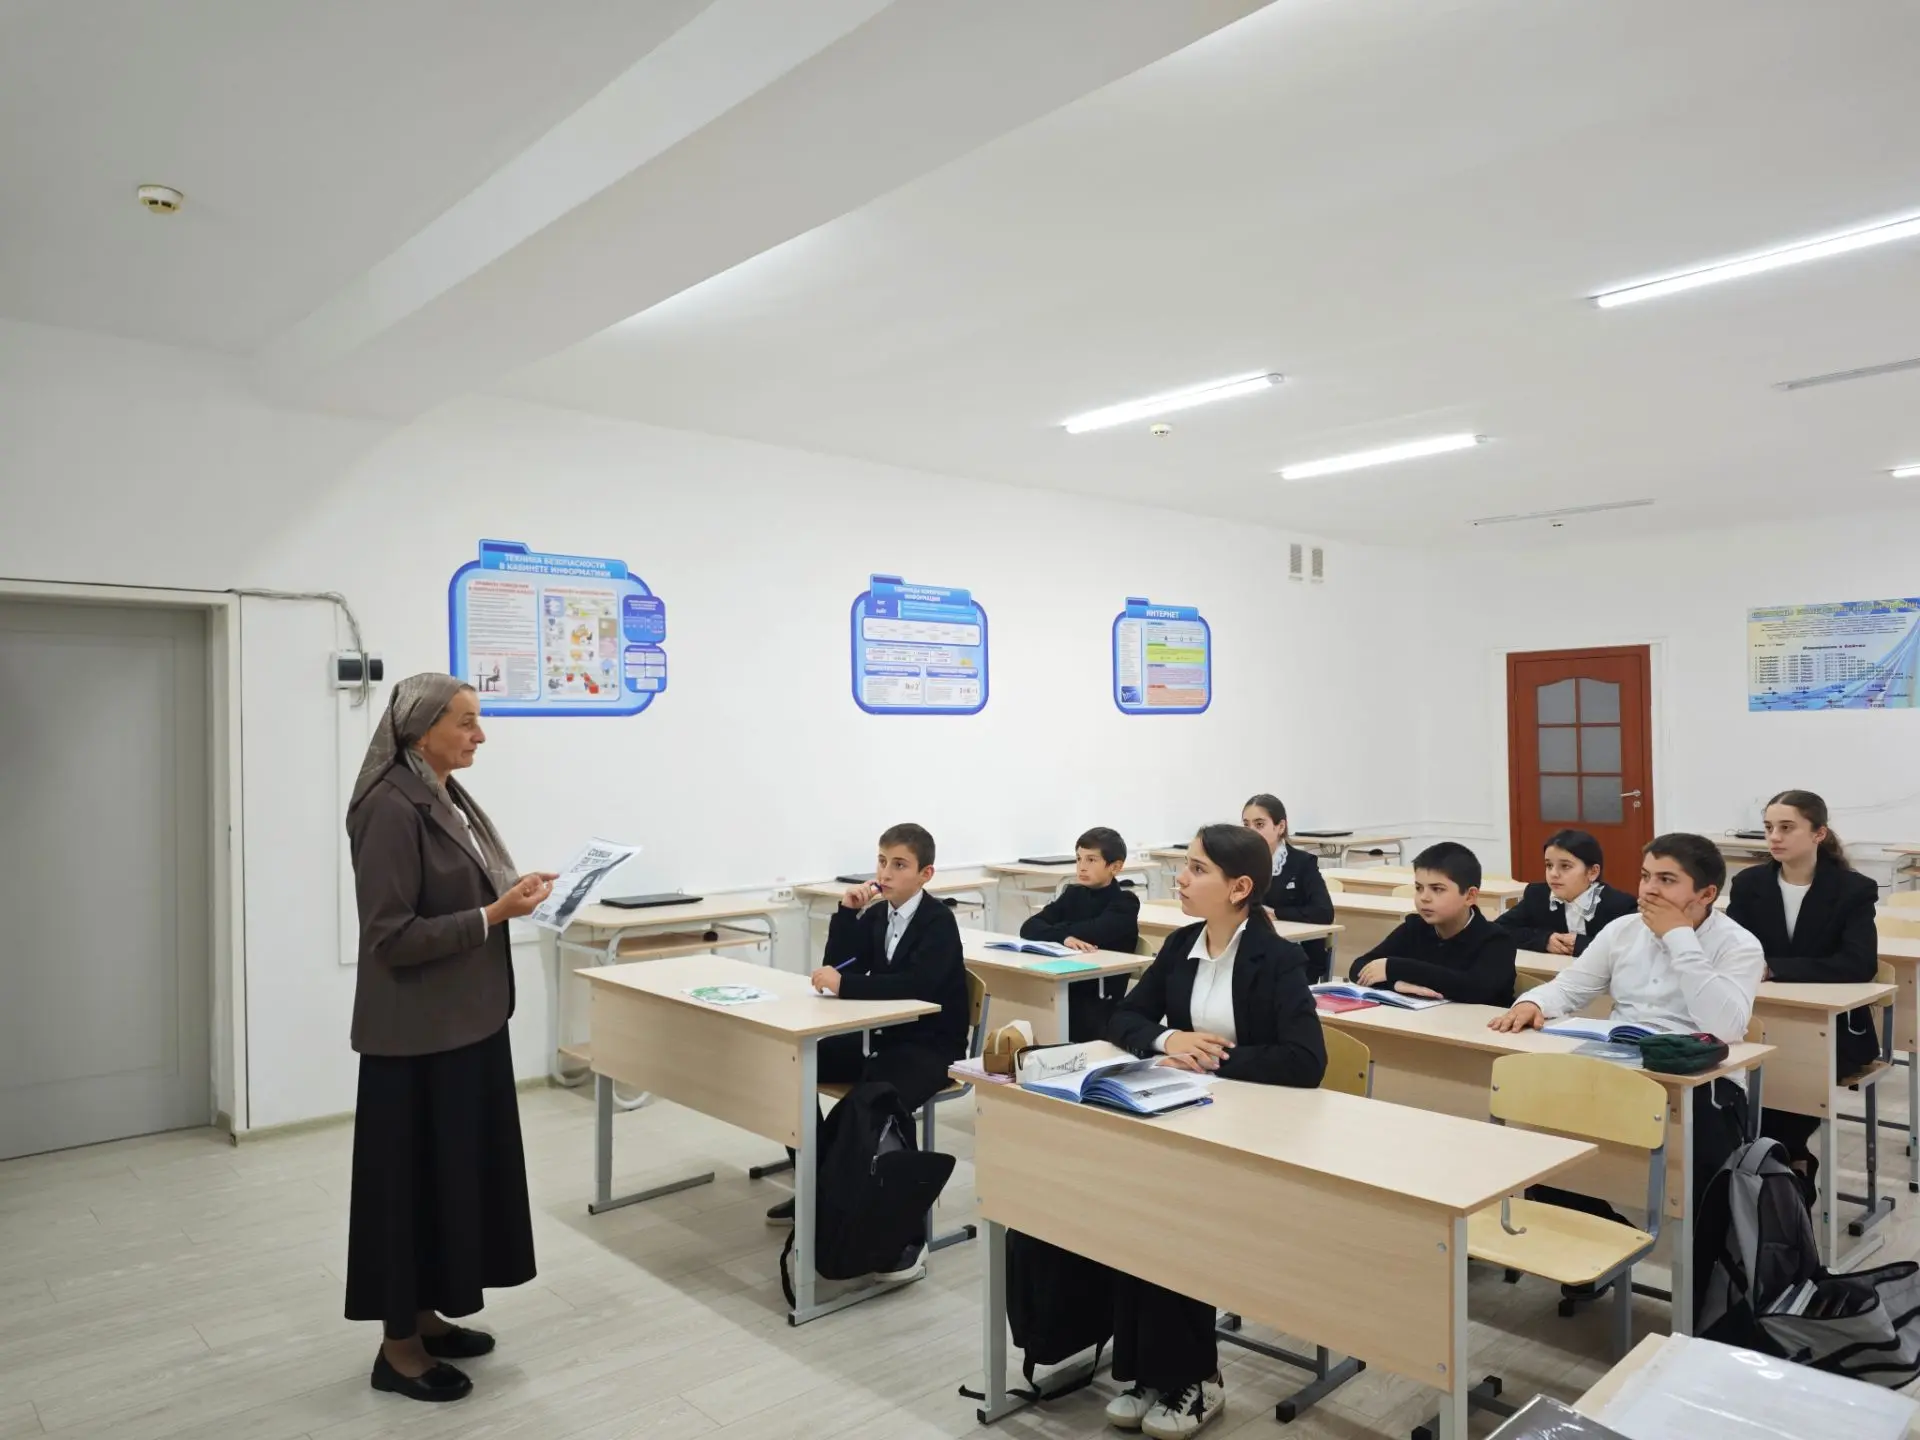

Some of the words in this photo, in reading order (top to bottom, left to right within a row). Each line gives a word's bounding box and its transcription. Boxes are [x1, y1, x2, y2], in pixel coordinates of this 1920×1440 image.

[504, 553, 541, 564] ТЕХНИКА
[543, 556, 606, 569] БЕЗОПАСНОСТИ
[499, 562, 505, 570] В
[507, 562, 548, 574] КАБИНЕТЕ
[550, 566, 611, 577] ИНФОРМАТИКИ
[1146, 609, 1180, 619] ИНТЕРНЕТ
